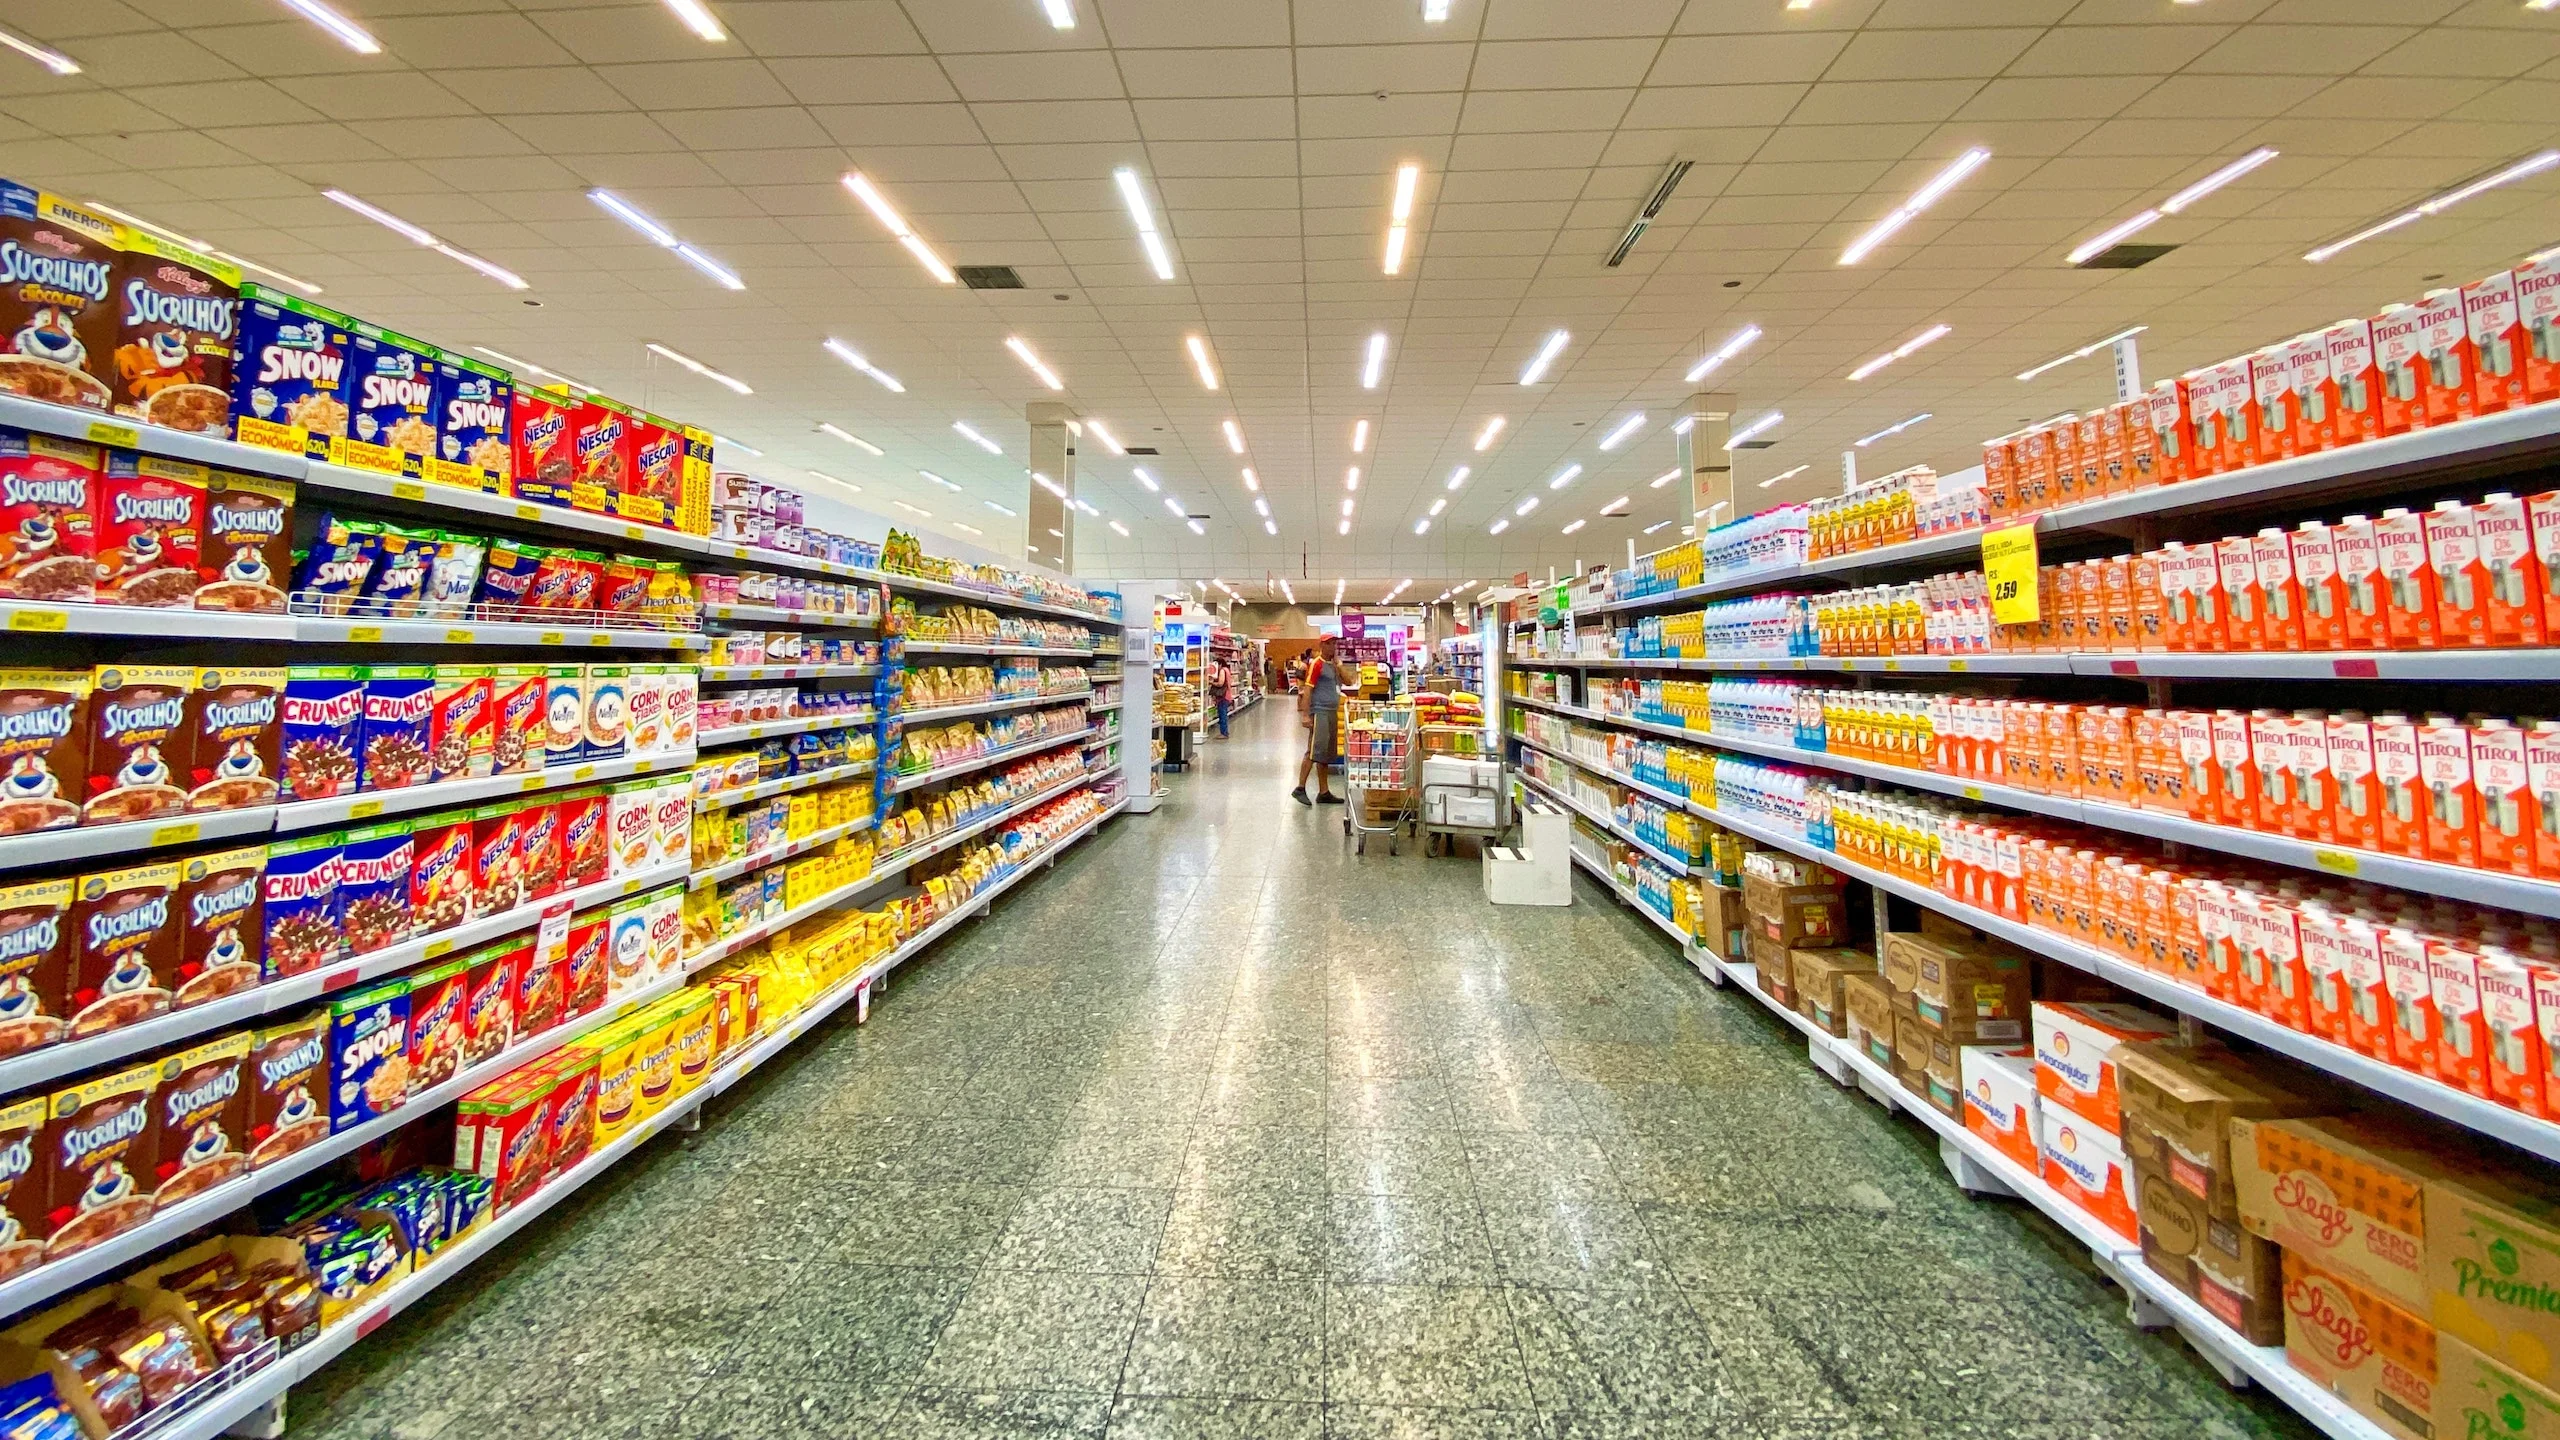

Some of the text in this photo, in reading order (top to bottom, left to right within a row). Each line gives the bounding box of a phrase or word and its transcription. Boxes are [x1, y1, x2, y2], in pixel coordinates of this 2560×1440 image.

[52, 203, 114, 236] ENERGIA
[0, 241, 111, 301] SUCRILHOS
[157, 265, 212, 293] Kellogg's
[126, 278, 234, 341] SUCRILHOS
[2467, 290, 2513, 313] TIROL
[2417, 307, 2461, 330] TIROL
[2374, 322, 2416, 343] TIROL
[2290, 351, 2326, 368] TIROL
[2329, 337, 2369, 357] TIROL
[259, 346, 344, 382] SNOW
[2254, 362, 2288, 380] TIROL
[313, 380, 339, 390] FLAKES
[362, 375, 431, 409] SNOW
[2190, 385, 2217, 400] TIROL
[2218, 375, 2248, 391] TIROL
[406, 404, 428, 413] FLAKES
[446, 400, 506, 430] SNOW
[2151, 395, 2176, 411] TIROL
[242, 419, 290, 436] EMBALAGEM
[524, 416, 564, 445] NESCAU
[577, 423, 623, 455] NESCAU
[240, 430, 304, 454] ECONÔMICA
[308, 439, 329, 458] 620g
[350, 443, 390, 456] EMBALAGEM
[348, 451, 401, 472] ECONÔMICA
[403, 460, 422, 476] 620g
[639, 441, 677, 471] NESCAU
[2, 474, 86, 507] SUCRILHOS
[245, 479, 294, 492] SABOR
[436, 470, 482, 488] ECONÔMICA
[115, 493, 193, 524] SUCRILHOS
[689, 460, 700, 533] ECONÔMICA
[701, 465, 711, 536] ECONÔMICA
[212, 504, 285, 535] SUCRILHOS
[629, 504, 661, 518] ECONÔMICA
[2377, 532, 2421, 547] TIROL
[2429, 525, 2474, 542] TIROL
[2478, 518, 2523, 536] TIROL
[2255, 549, 2287, 562] TIROL
[2294, 543, 2332, 557] TIROL
[2335, 537, 2376, 552] TIROL
[2160, 560, 2186, 573] TIROL
[2186, 557, 2214, 569] TIROL
[2220, 553, 2254, 566] TIROL
[311, 560, 374, 586] SNOW
[533, 569, 569, 598] NESCAU
[611, 577, 648, 604] NESCAU
[9, 674, 90, 683] O SABOR
[127, 668, 195, 677] O SABOR
[240, 670, 286, 678] SABOR
[284, 691, 362, 722] CRUNCH
[365, 690, 434, 719] CRUNCH
[446, 688, 488, 725] NESCAU
[505, 686, 542, 720] NESCAU
[630, 690, 660, 712] CORN
[667, 688, 693, 708] CORN
[103, 696, 184, 738] SUCRILHOS
[205, 695, 276, 735] SUCRILHOS
[2181, 726, 2208, 741] TIROL
[2214, 728, 2245, 743] TIROL
[2253, 731, 2285, 745] TIROL
[2286, 733, 2324, 749] TIROL
[2328, 736, 2369, 753] TIROL
[2376, 738, 2414, 756] TIROL
[2421, 741, 2466, 759] TIROL
[2474, 745, 2523, 763] TIROL
[617, 803, 648, 831] CORN
[658, 797, 686, 823] CORN
[567, 805, 601, 848] NESCAU
[210, 849, 266, 865] O SABOR
[480, 824, 520, 873] NESCAU
[111, 865, 180, 882] O SABOR
[342, 844, 414, 882] CRUNCH
[417, 834, 467, 889] NESCAU
[266, 857, 344, 898] CRUNCH
[14, 883, 71, 898] SABOR
[192, 876, 258, 927] SUCRILHOS
[2198, 899, 2228, 918] TIROL
[2230, 908, 2260, 927] TIROL
[89, 895, 169, 950] SUCRILHOS
[652, 909, 678, 939] CORN
[2260, 918, 2294, 938] TIROL
[570, 928, 606, 977] NESCAU
[2301, 929, 2338, 951] TIROL
[2339, 940, 2377, 961] TIROL
[2384, 951, 2427, 974] TIROL
[2431, 962, 2474, 988] TIROL
[468, 965, 512, 1024] NESCAU
[2481, 976, 2529, 1001] TIROL
[413, 984, 463, 1049] NESCAU
[186, 1034, 249, 1061] O SABOR
[680, 1022, 712, 1050] Cheerios
[341, 1020, 408, 1079] SNOW
[640, 1043, 677, 1072] Cheerios
[260, 1034, 324, 1091] SUCRILHOS
[2038, 1049, 2088, 1084] Piracanjuba
[84, 1067, 156, 1096] O SABOR
[599, 1060, 638, 1096] Cheerios
[167, 1064, 240, 1127] SUCRILHOS
[554, 1074, 597, 1133] NESCAU
[1965, 1089, 2006, 1123] Piracanjuba
[63, 1098, 148, 1167] SUCRILHOS
[506, 1103, 549, 1167] NESCAU
[2366, 1223, 2417, 1258] ZERO
